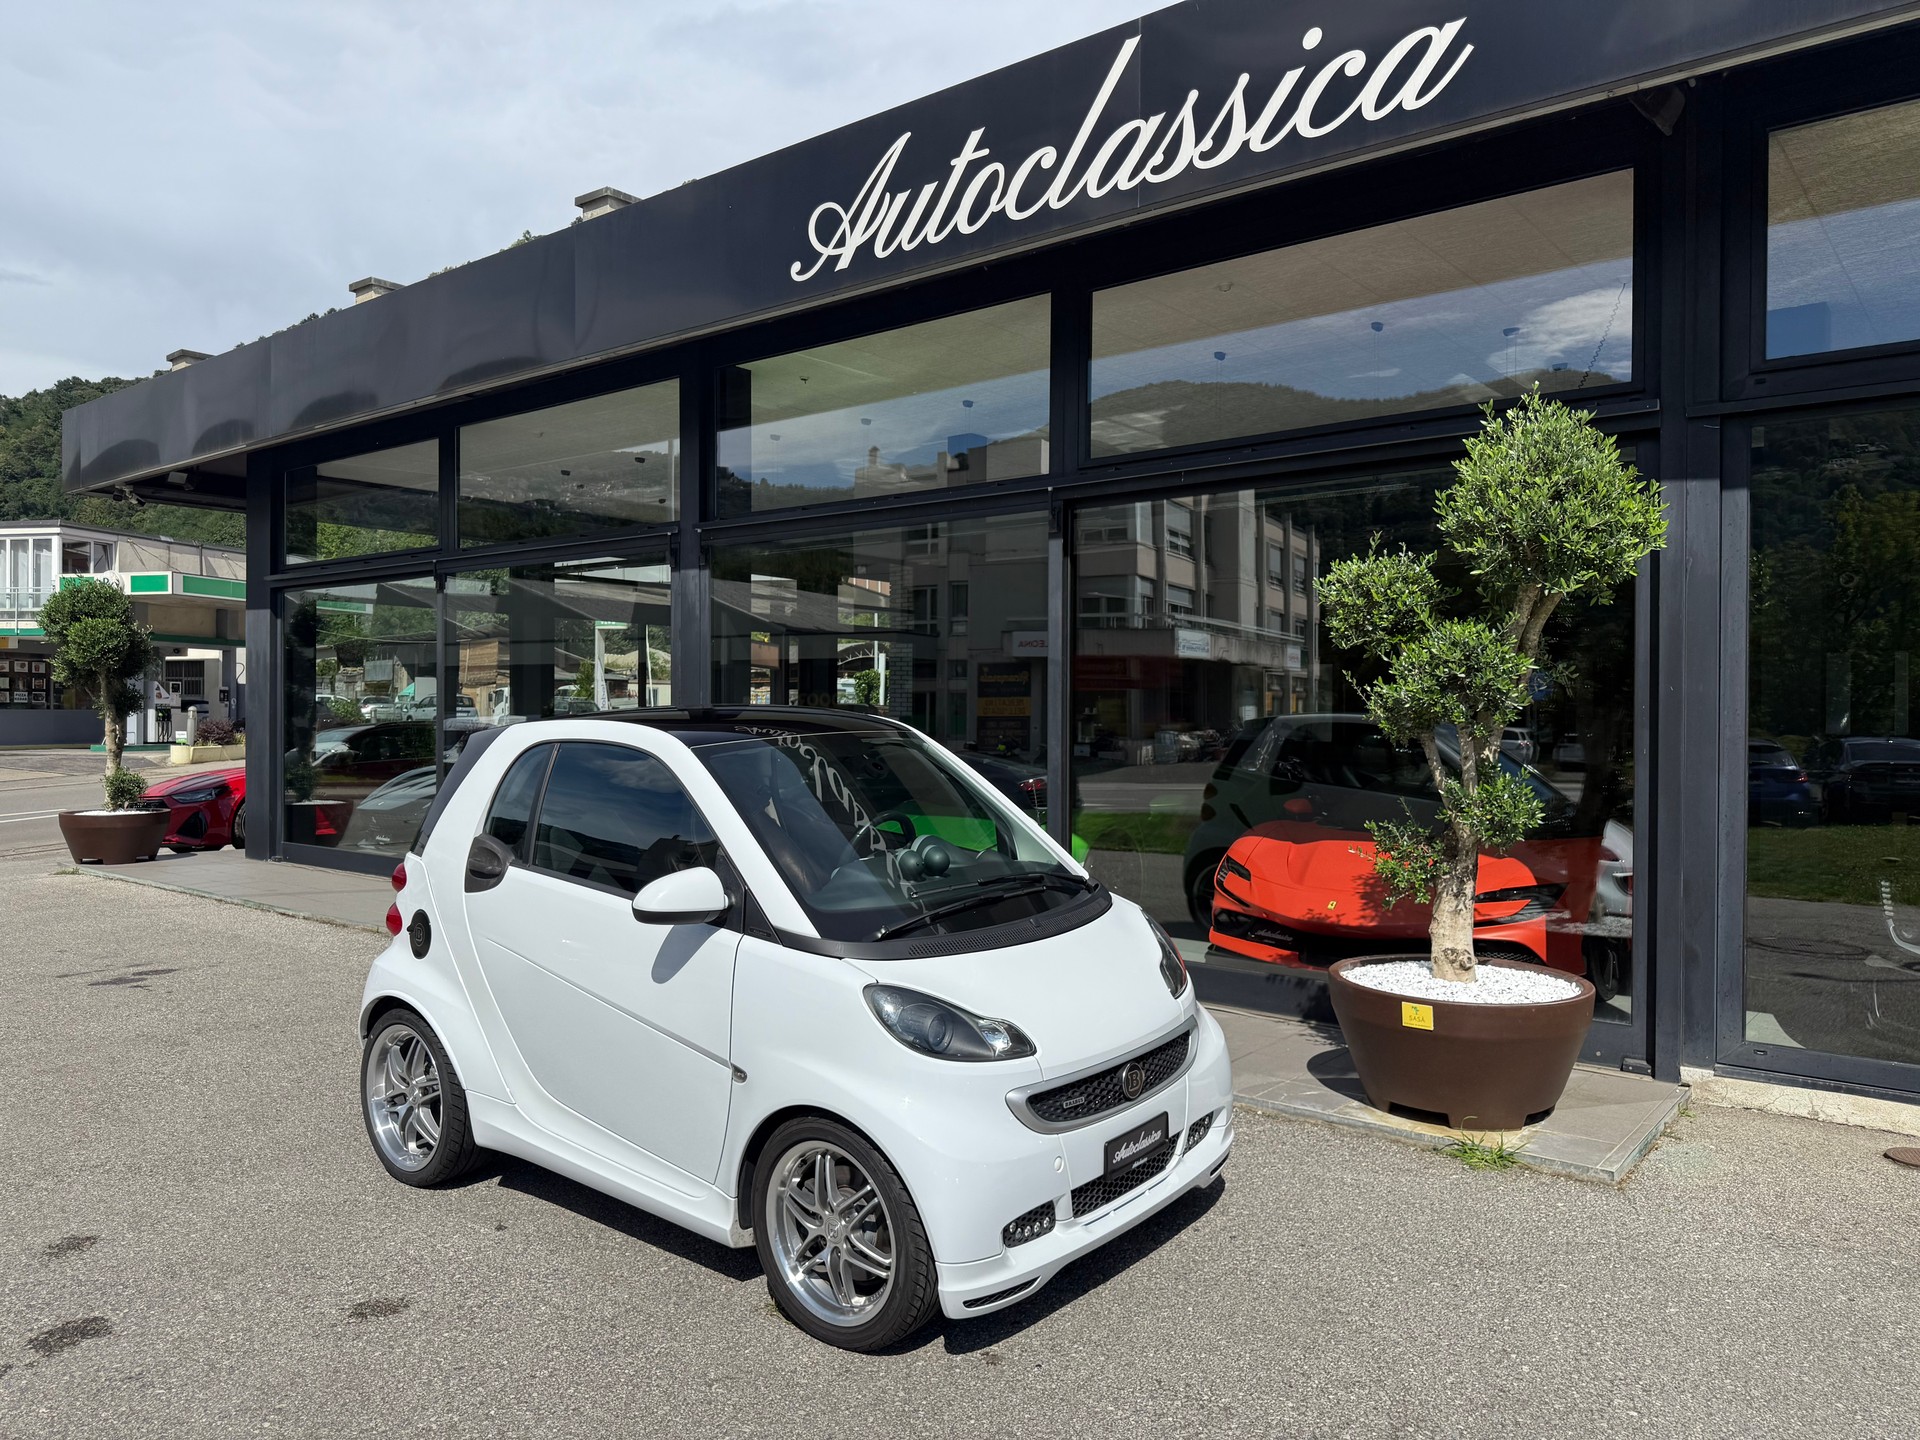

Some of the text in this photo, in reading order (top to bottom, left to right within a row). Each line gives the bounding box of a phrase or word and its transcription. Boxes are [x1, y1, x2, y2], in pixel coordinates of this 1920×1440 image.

[790, 17, 1474, 282] Autoclassica
[1128, 1070, 1141, 1092] B
[1112, 1130, 1161, 1163] Autoclassica
